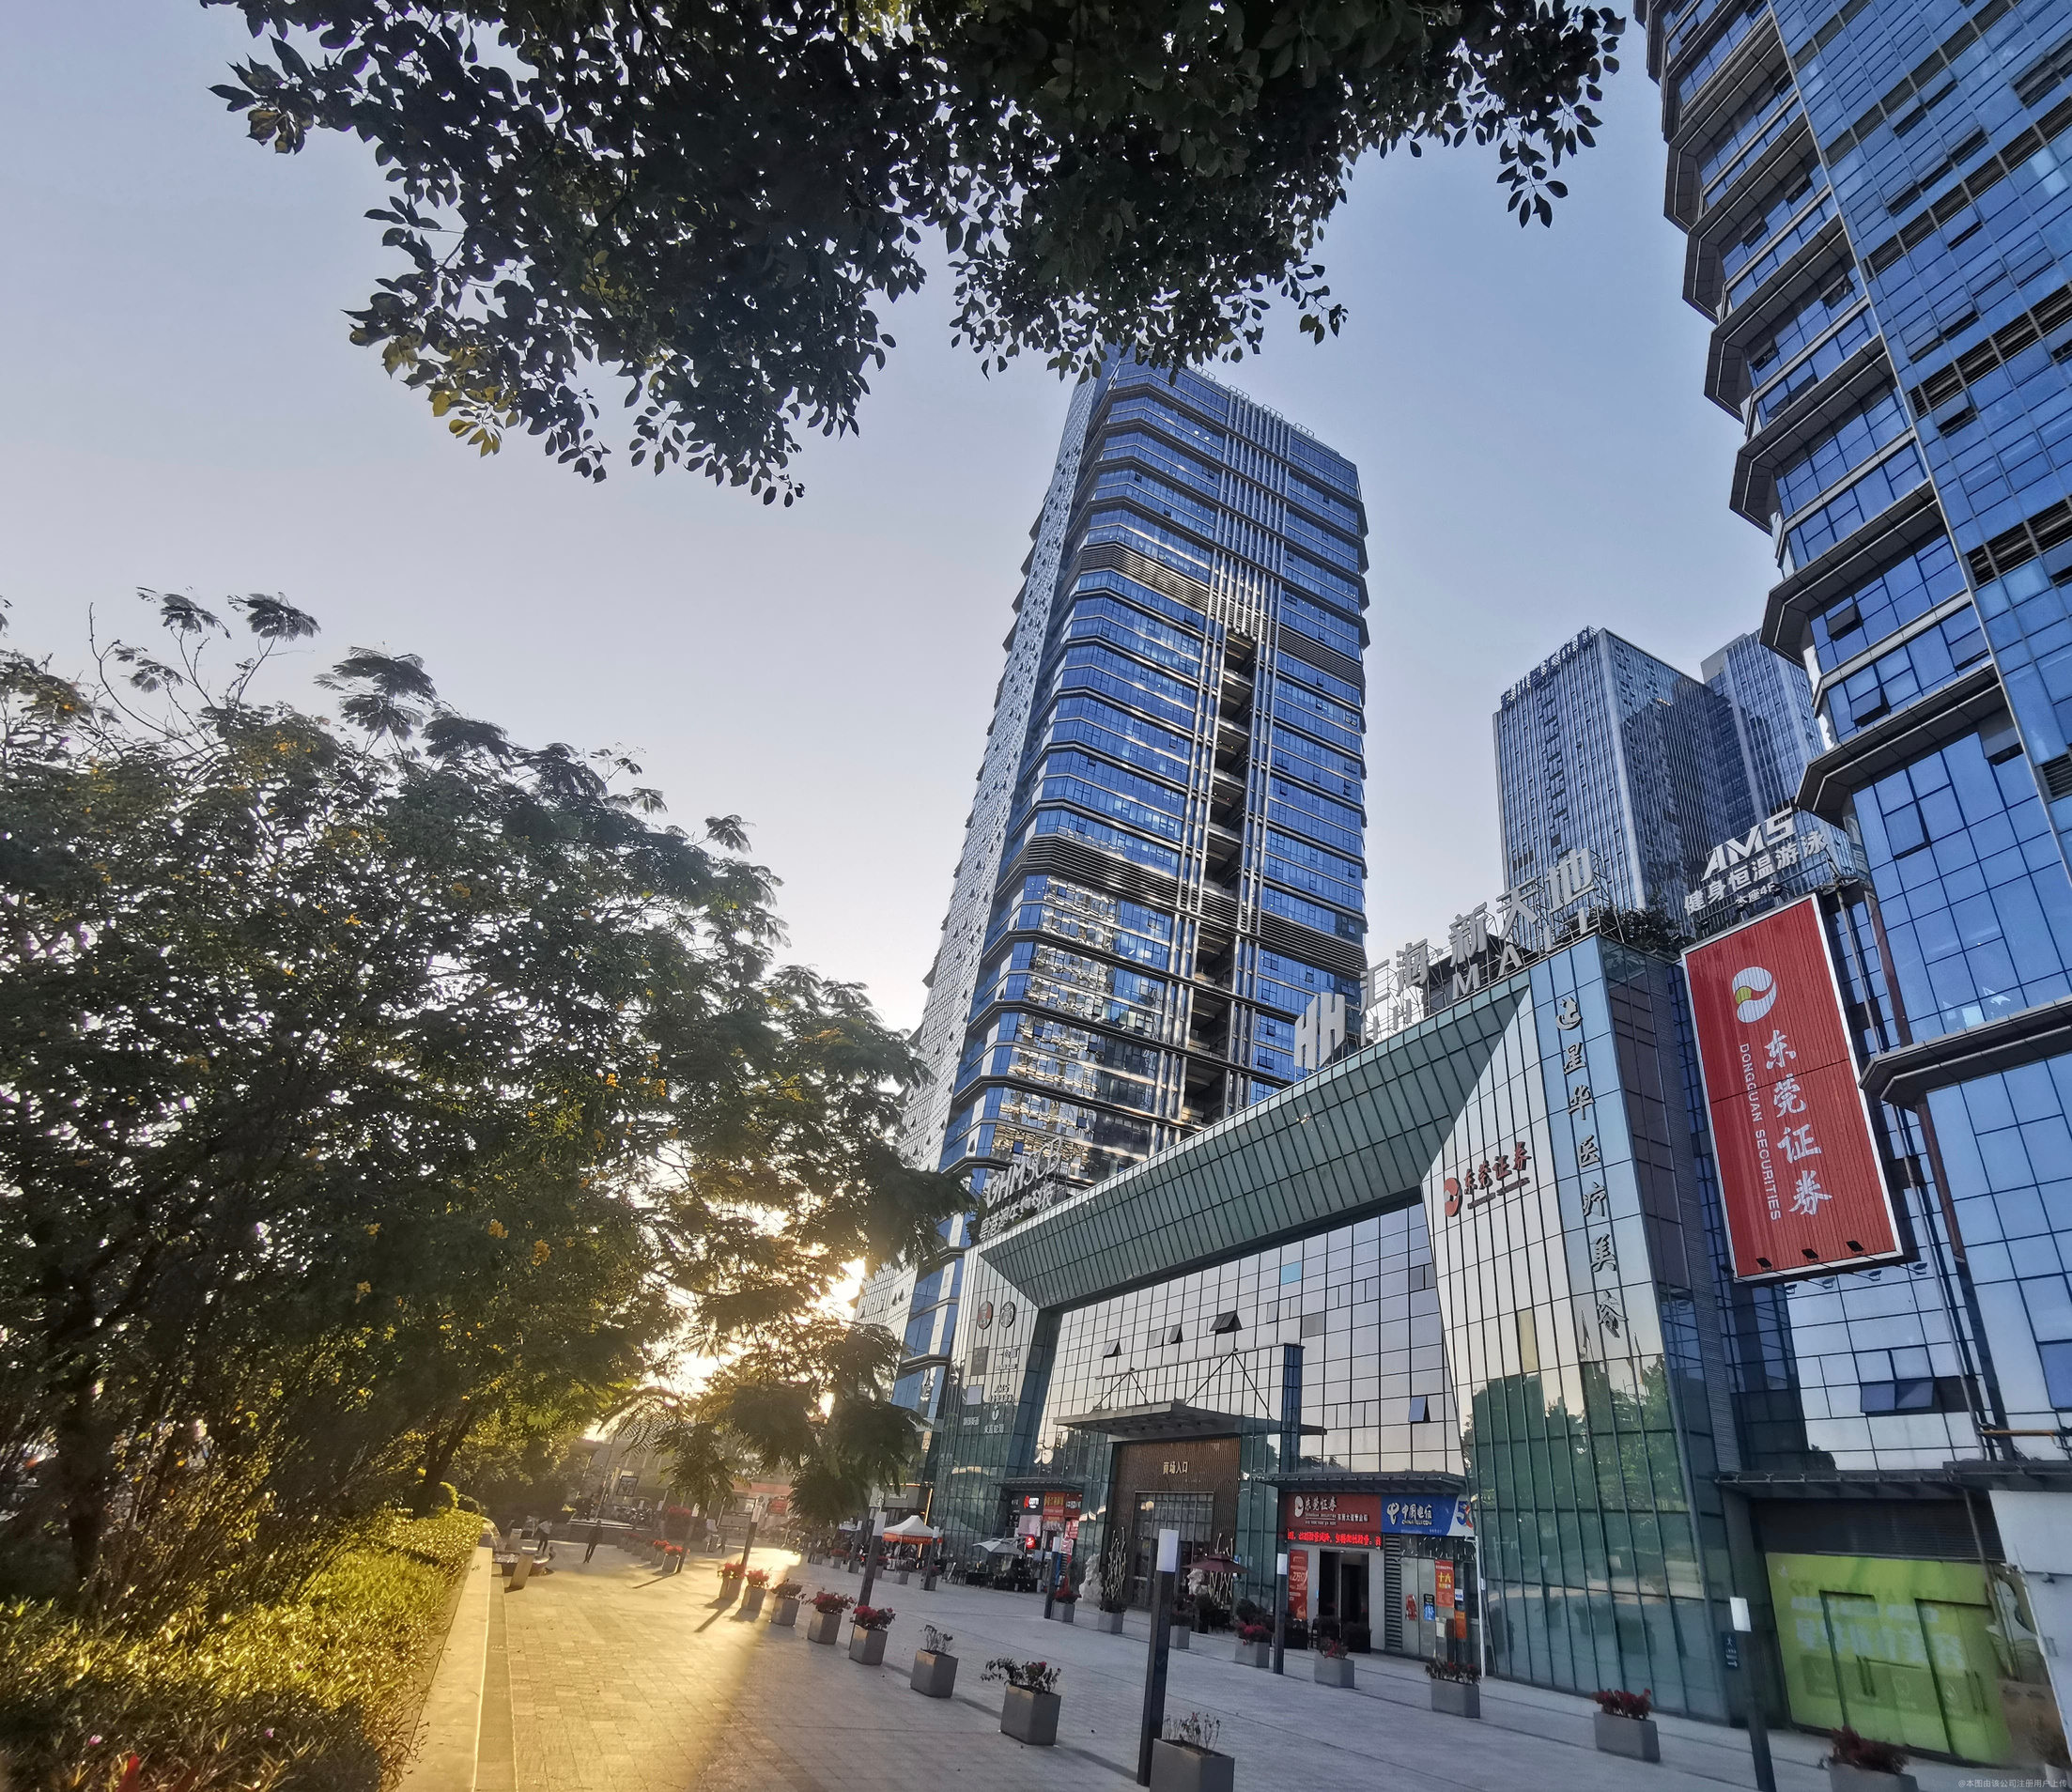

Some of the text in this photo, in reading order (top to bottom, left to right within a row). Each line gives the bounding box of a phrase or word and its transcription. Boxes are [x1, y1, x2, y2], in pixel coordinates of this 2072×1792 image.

[1684, 830, 1827, 917] 健身恒温游泳
[1701, 806, 1794, 882] AMS
[1739, 1043, 1782, 1221] DONGGUAN SECURITIES
[1764, 1029, 1833, 1218] 东莞证券
[1464, 1141, 1532, 1196] 东莞证券
[1562, 1041, 1630, 1338] 星华医疗美容
[1163, 1460, 1188, 1475] 商场入口
[1305, 1495, 1338, 1512] 东莞证券
[1401, 1504, 1432, 1521] 中国电信
